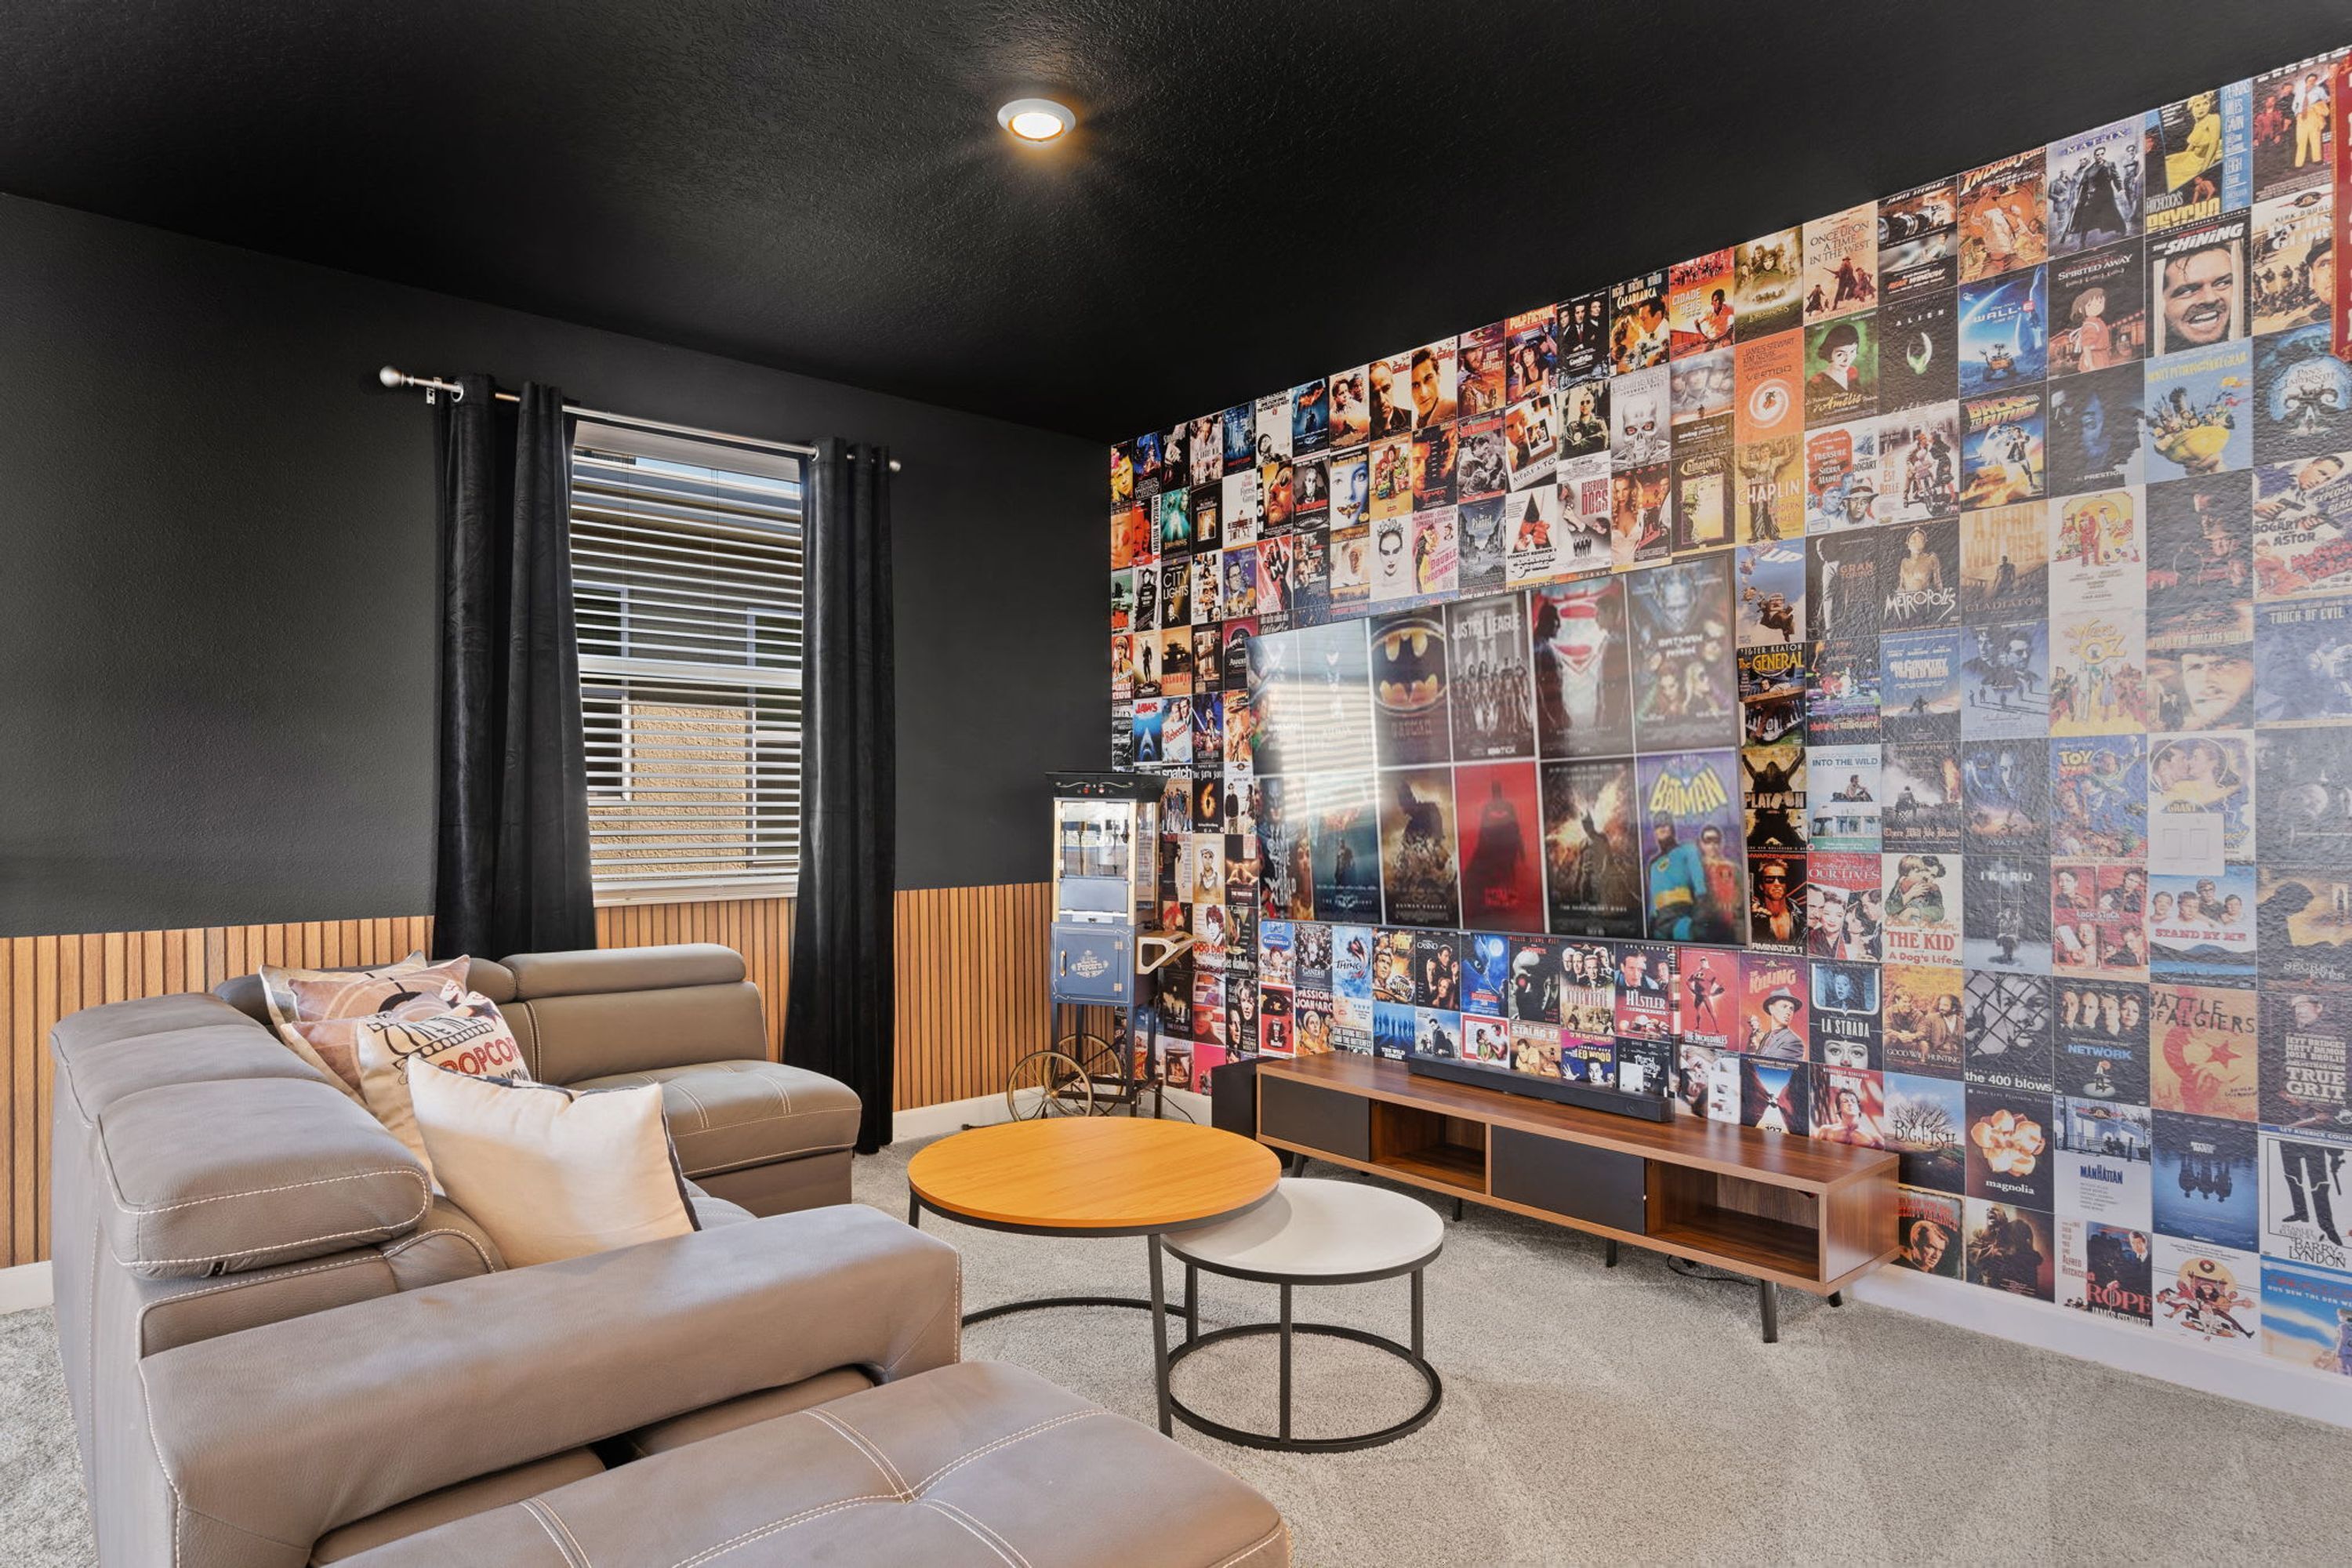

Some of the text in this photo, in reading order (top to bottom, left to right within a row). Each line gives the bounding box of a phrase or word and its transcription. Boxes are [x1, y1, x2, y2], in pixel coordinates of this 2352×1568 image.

[1886, 181, 1946, 205] JAMES STEWART
[1809, 220, 1870, 247] ONCE UPON
[1809, 238, 1871, 265] IN THE WEST
[1824, 234, 1857, 252] A TIME
[2058, 253, 2133, 281] SPIRITED AWAY
[1617, 287, 1657, 310] CASABLANCA
[1671, 288, 1701, 307] CIDADE
[1895, 308, 1945, 327] ALIEN
[1746, 365, 1792, 382] VERTIGO
[1581, 477, 1609, 493] RESERVOIR
[1737, 478, 1801, 506] CHAPLIN
[1581, 489, 1609, 515] DOGS
[2274, 532, 2316, 546] ASTOR
[1840, 561, 1875, 573] GRAN
[1163, 567, 1189, 588] CITY
[1163, 583, 1189, 600] LIGHTS
[1884, 586, 1957, 622] METROPOLIS
[1965, 597, 2042, 612] GLADIATOR
[2270, 610, 2301, 625] TOUCH
[2321, 606, 2344, 620] EVIL
[1770, 643, 1802, 654] KEATON
[1753, 652, 1805, 672] GENERAL
[1905, 658, 1947, 670] COUNTRY
[1136, 702, 1158, 714] JAWS
[1812, 757, 1878, 767] INTO THE WILD
[2057, 750, 2094, 766] TOY
[1162, 766, 1192, 779] snatch
[1649, 767, 1730, 815] BATMAN
[2168, 800, 2198, 813] GRANT
[1905, 828, 1924, 838] Will
[1936, 828, 1960, 839] Blood
[1838, 869, 1880, 880] LIVES
[1980, 870, 2033, 882] IKIRU
[2154, 927, 2247, 941] STAND BY ME
[1193, 942, 1210, 953] DOG
[1752, 942, 1796, 954] RMINATOR
[1888, 951, 1952, 965] A Dog's Life
[1298, 989, 1330, 1001] PASSION
[1820, 1018, 1870, 1038] LA STRADA
[2165, 1007, 2256, 1034] ALGIERS
[2286, 1036, 2347, 1048] JEFF BRIDGES
[1577, 1050, 1612, 1062] ED WOOD
[2067, 1044, 2132, 1061] NETWORK
[2286, 1051, 2347, 1063] JOSH BROLIN
[2314, 1047, 2347, 1056] DAMON
[1965, 1071, 2053, 1094] the 400 blows
[2285, 1066, 2347, 1087] TRUE
[2285, 1079, 2347, 1100] GRIT
[2079, 1163, 2124, 1185] MANHATTAN
[1985, 1179, 2035, 1196] magnolia
[2294, 1236, 2335, 1254] BARRY
[2061, 1255, 2082, 1269] ALFRED
[2288, 1244, 2347, 1269] LYNDON
[2086, 1283, 2152, 1317] ROPE
